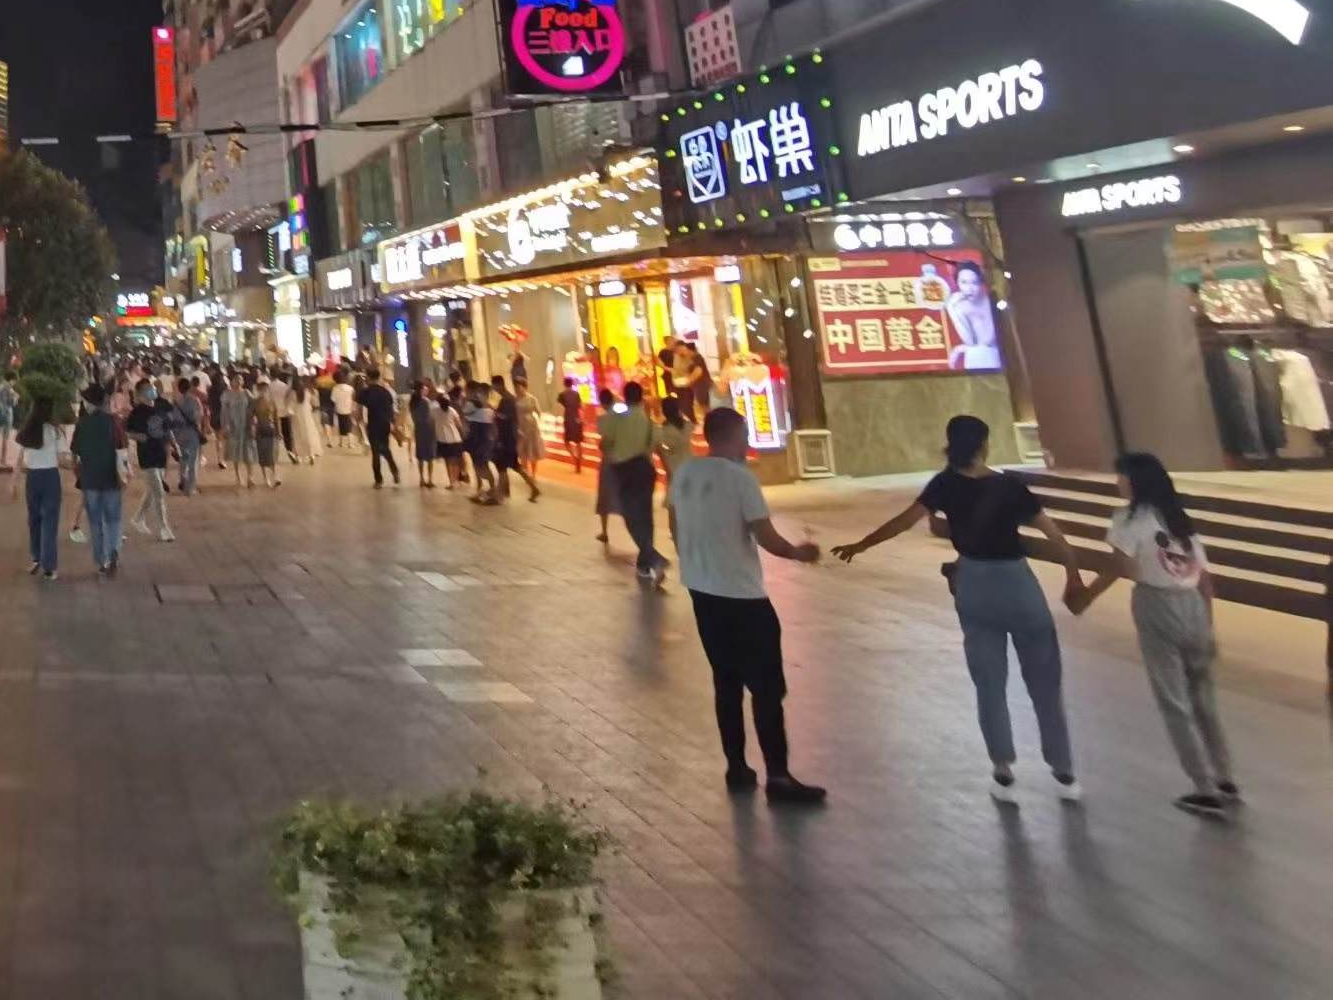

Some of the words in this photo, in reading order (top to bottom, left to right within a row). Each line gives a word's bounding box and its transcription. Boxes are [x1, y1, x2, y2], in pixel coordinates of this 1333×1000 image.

[858, 100, 917, 157] ANTA
[918, 58, 1044, 139] SPORTS
[731, 102, 815, 184] 虾巢
[1101, 176, 1181, 210] SPORTS
[826, 314, 945, 354] 中国黄金
